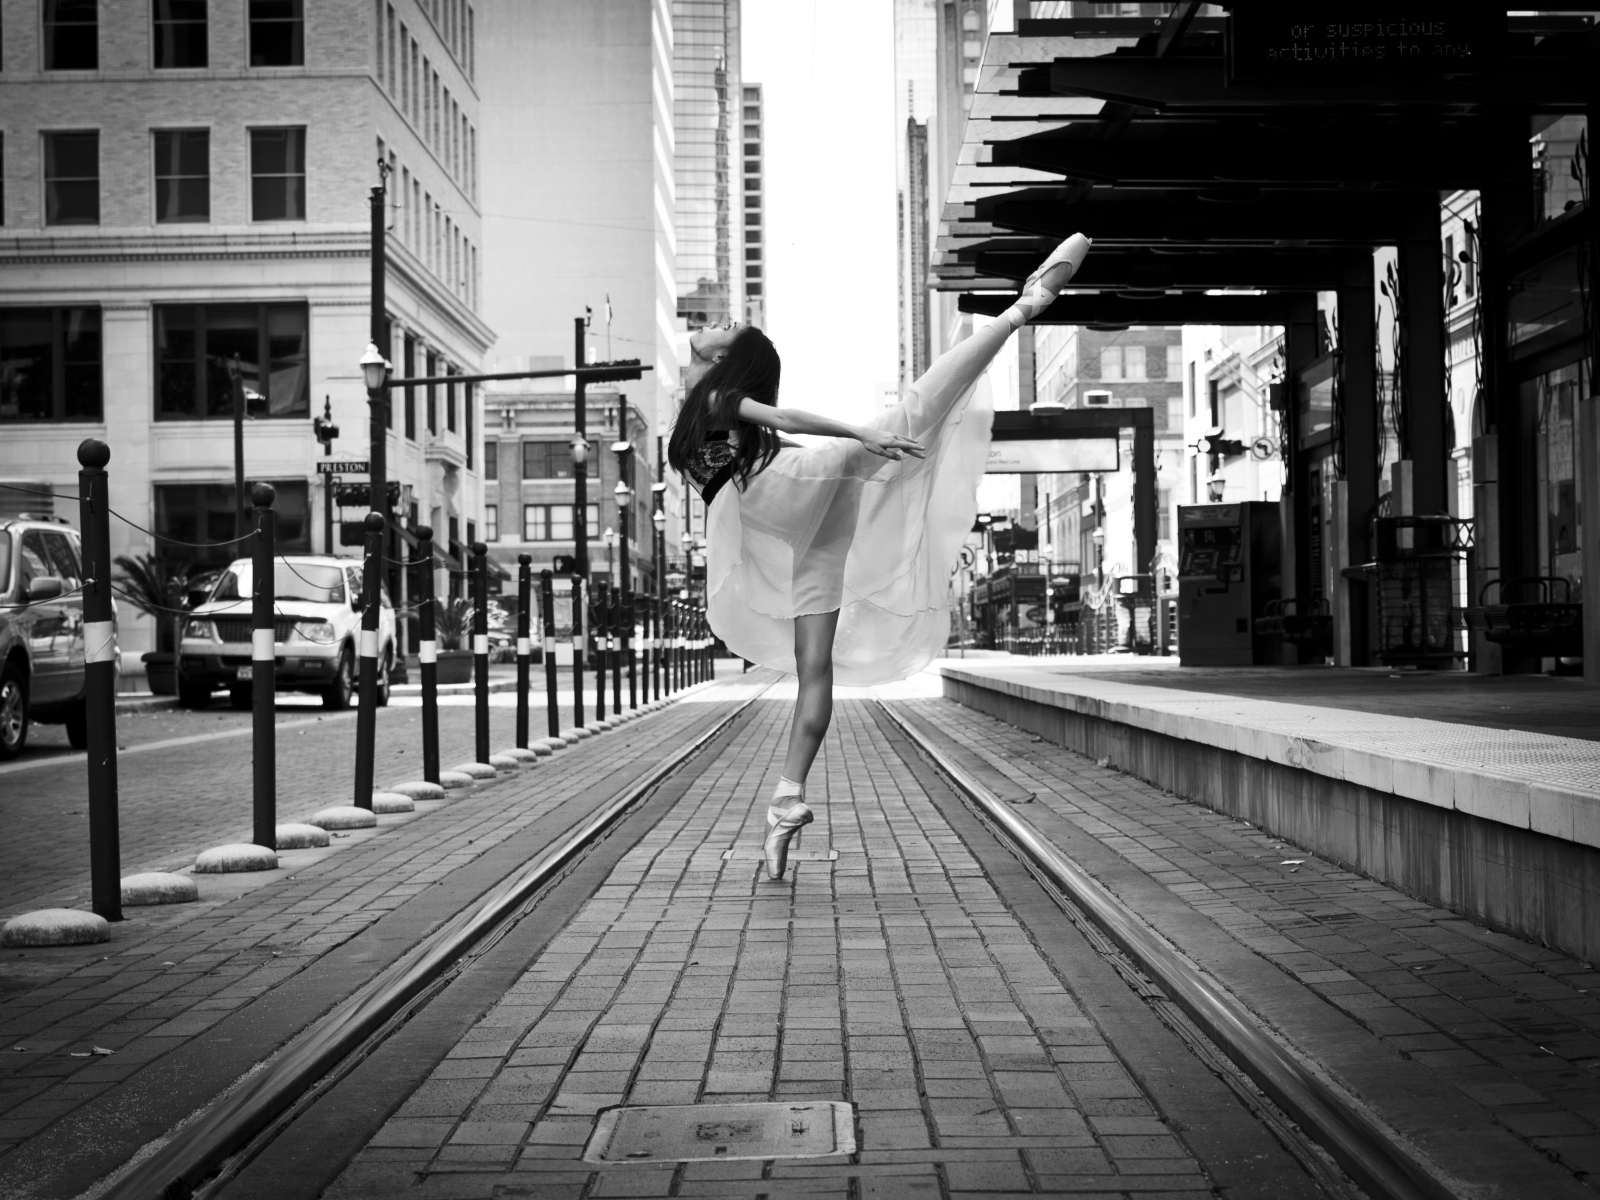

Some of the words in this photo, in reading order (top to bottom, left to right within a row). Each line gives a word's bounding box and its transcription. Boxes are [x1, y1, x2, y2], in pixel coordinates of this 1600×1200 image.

[1291, 25, 1314, 38] or
[1326, 18, 1445, 38] suspicious
[1268, 42, 1386, 61] activities
[320, 462, 366, 473] PRESTON
